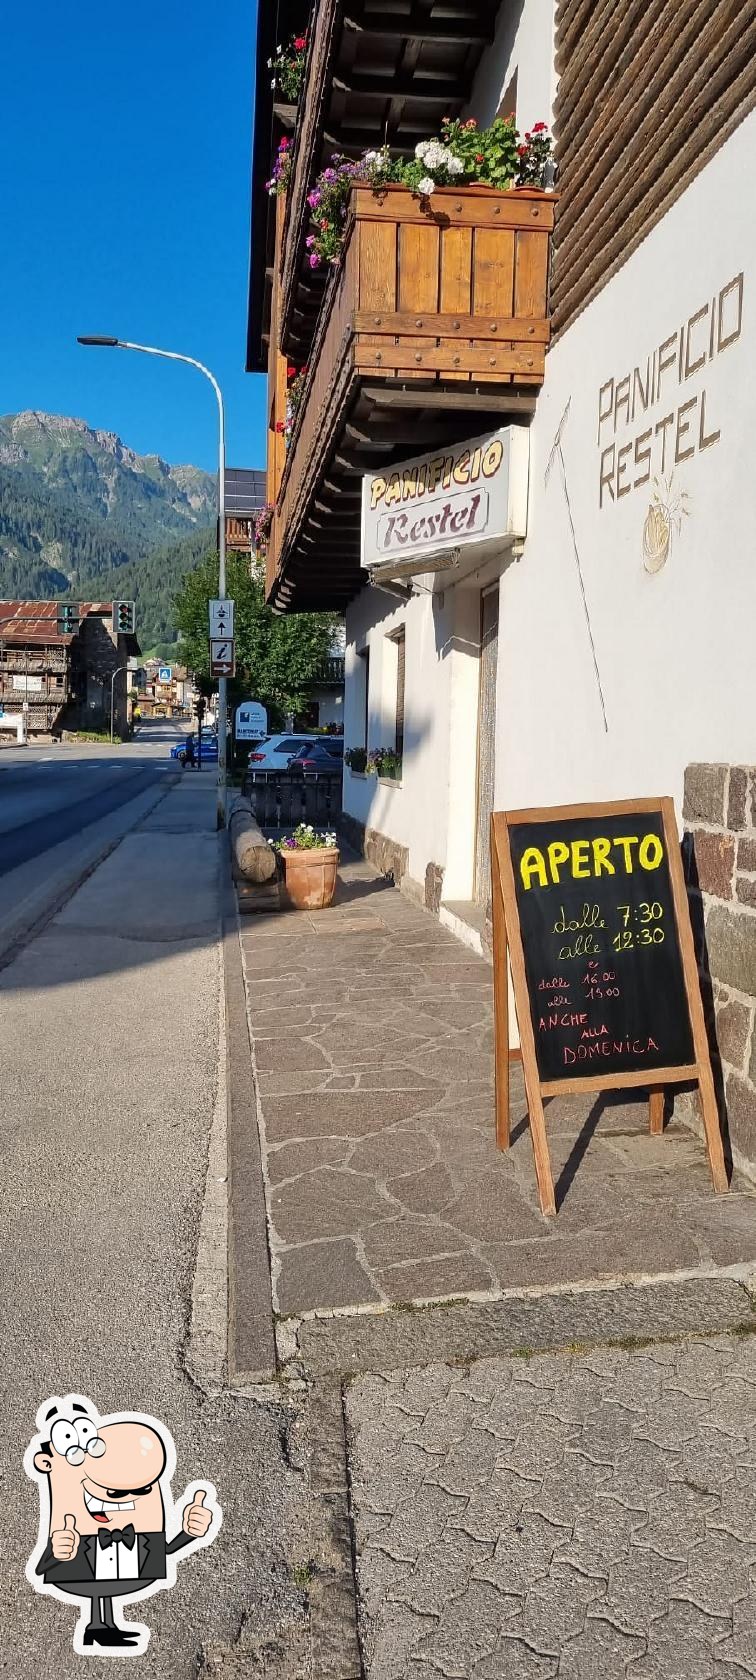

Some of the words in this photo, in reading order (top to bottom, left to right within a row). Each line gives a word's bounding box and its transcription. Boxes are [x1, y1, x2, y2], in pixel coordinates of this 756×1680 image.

[597, 271, 744, 447] PANIFICIO
[599, 389, 721, 509] RESTEL
[370, 440, 504, 511] PANIFICIO
[383, 493, 481, 548] Restel
[520, 833, 664, 891] APERTO
[551, 903, 609, 934] dalle
[616, 902, 664, 928] 7:30
[558, 934, 602, 961] alle
[612, 927, 666, 953] 12:30
[538, 977, 570, 990] dalle
[547, 995, 573, 1008] alle
[539, 1013, 588, 1032] ANCHE
[580, 1024, 609, 1040] ALLA
[562, 1034, 660, 1065] DOMENICA
